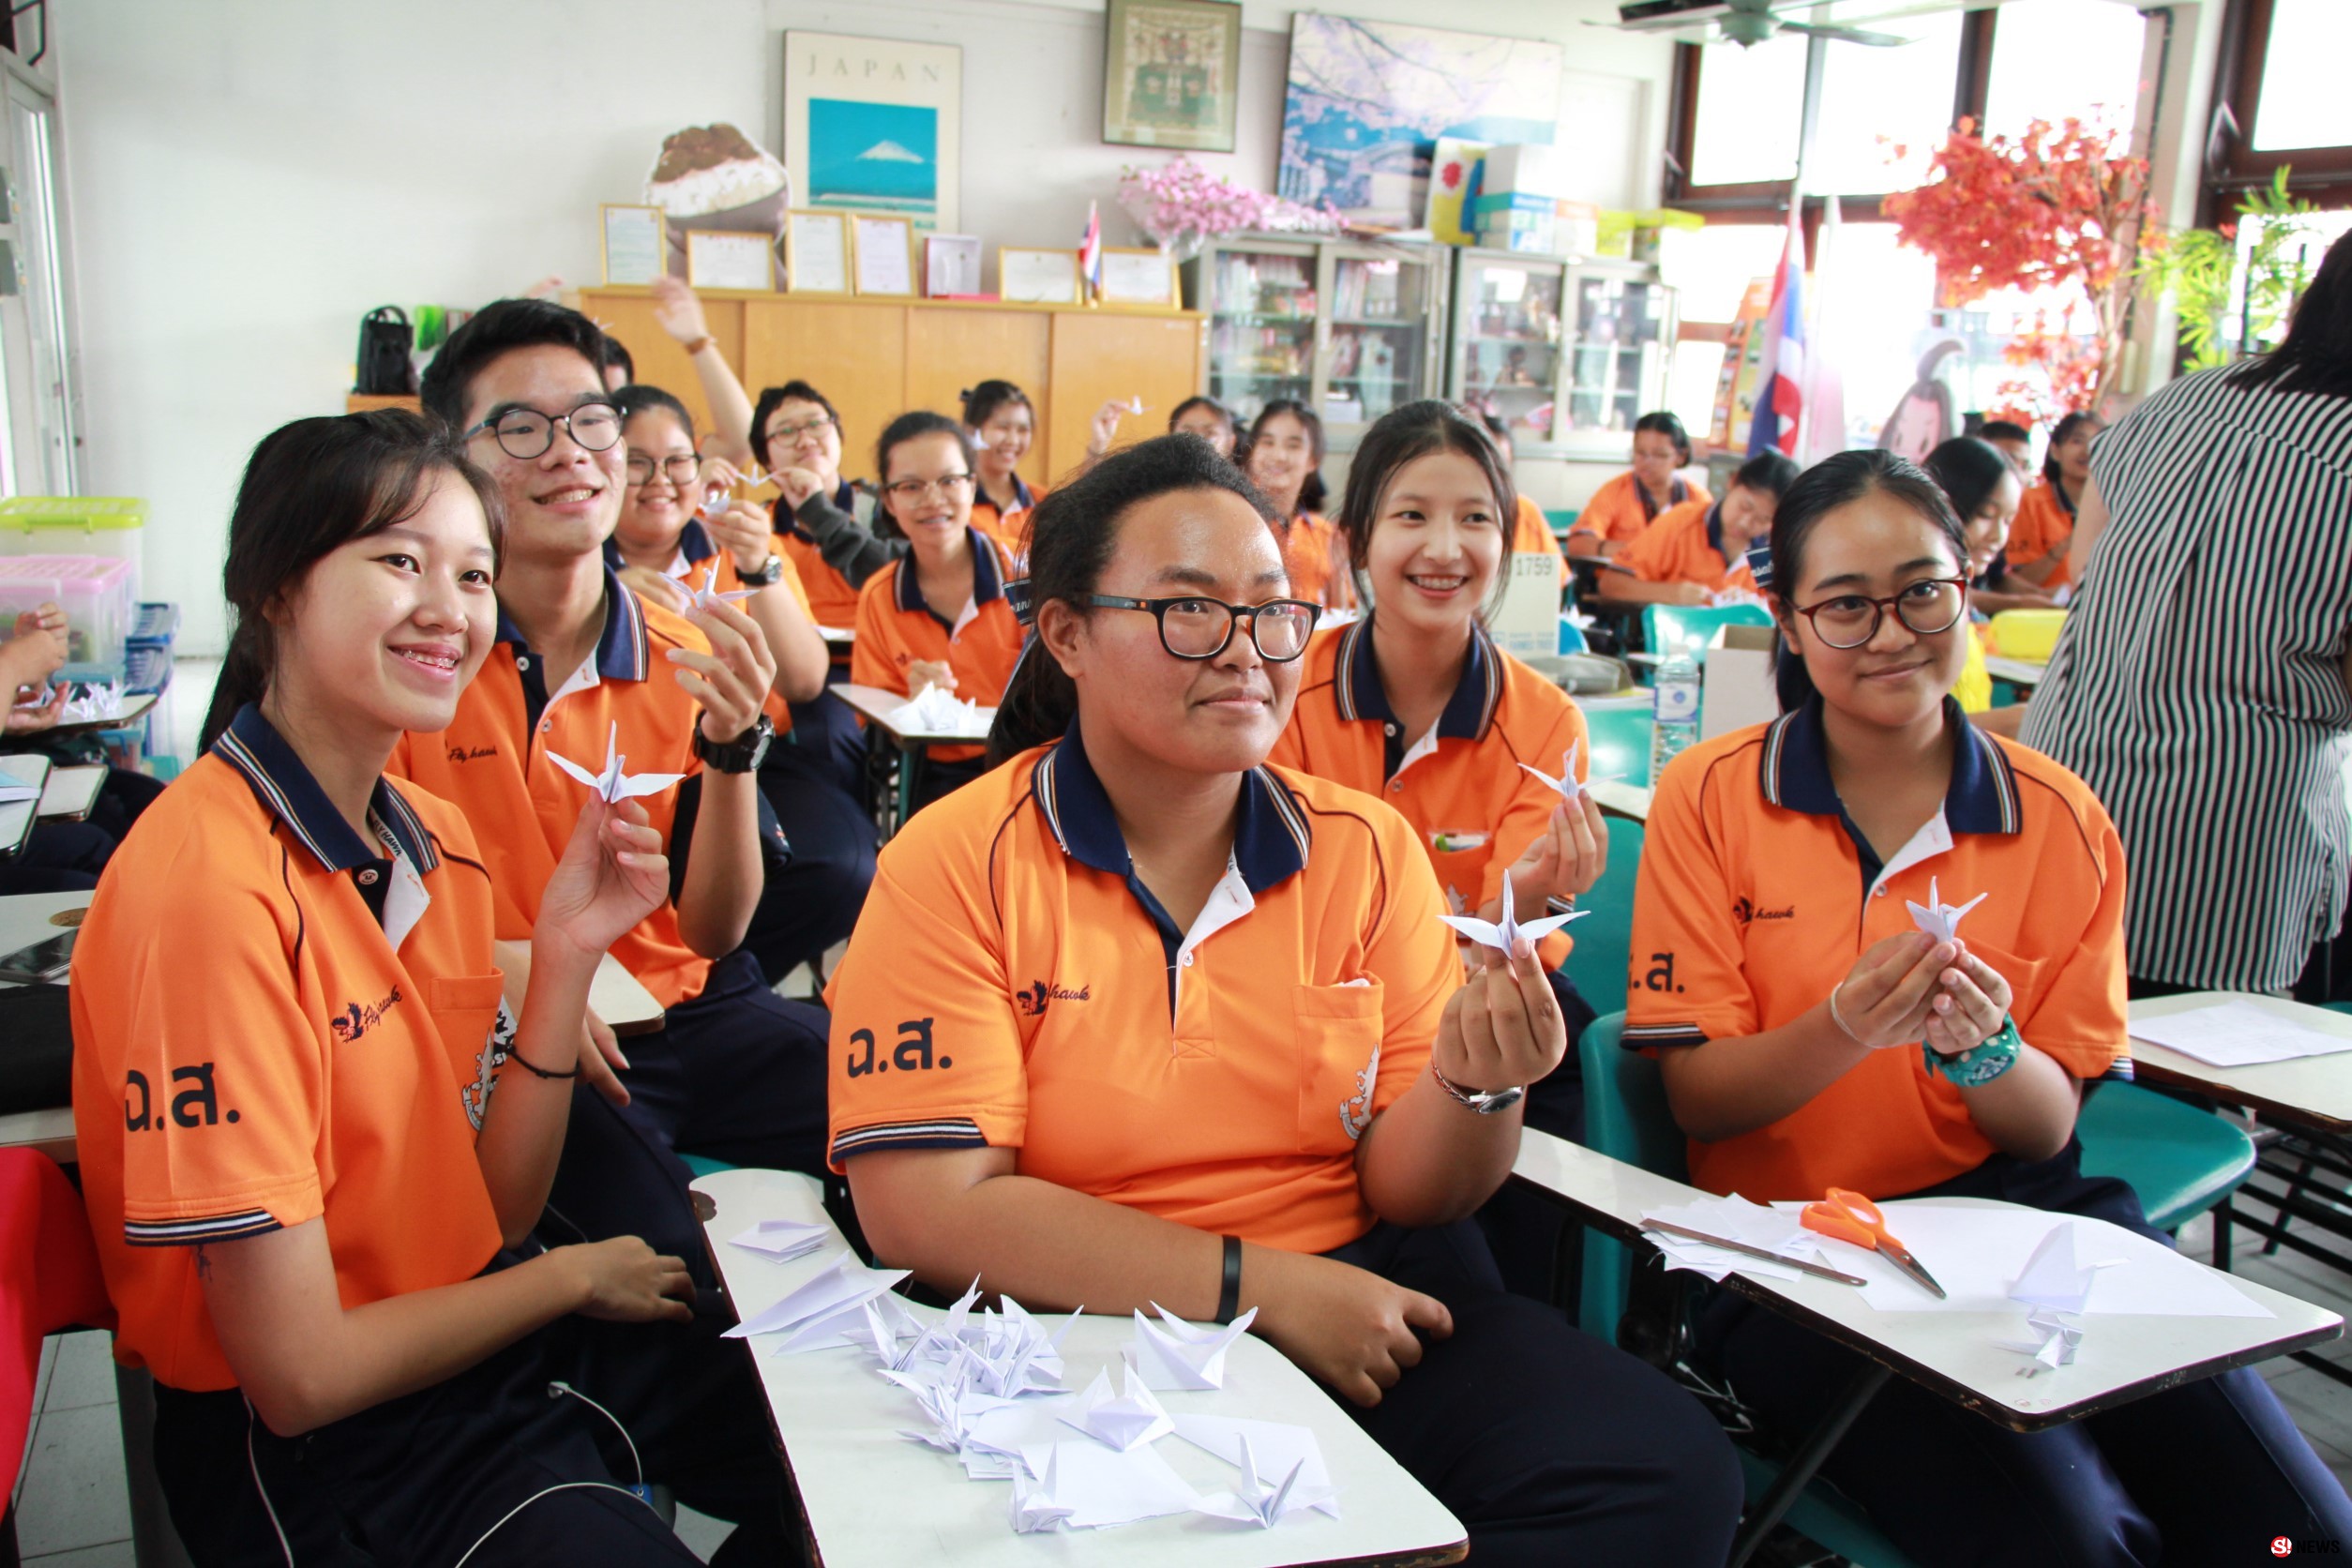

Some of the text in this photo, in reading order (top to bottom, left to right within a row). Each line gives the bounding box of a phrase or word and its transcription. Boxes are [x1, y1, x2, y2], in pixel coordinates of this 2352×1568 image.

[807, 53, 941, 83] JAPAN
[1515, 556, 1552, 577] 1759
[1754, 905, 1795, 920] hawk
